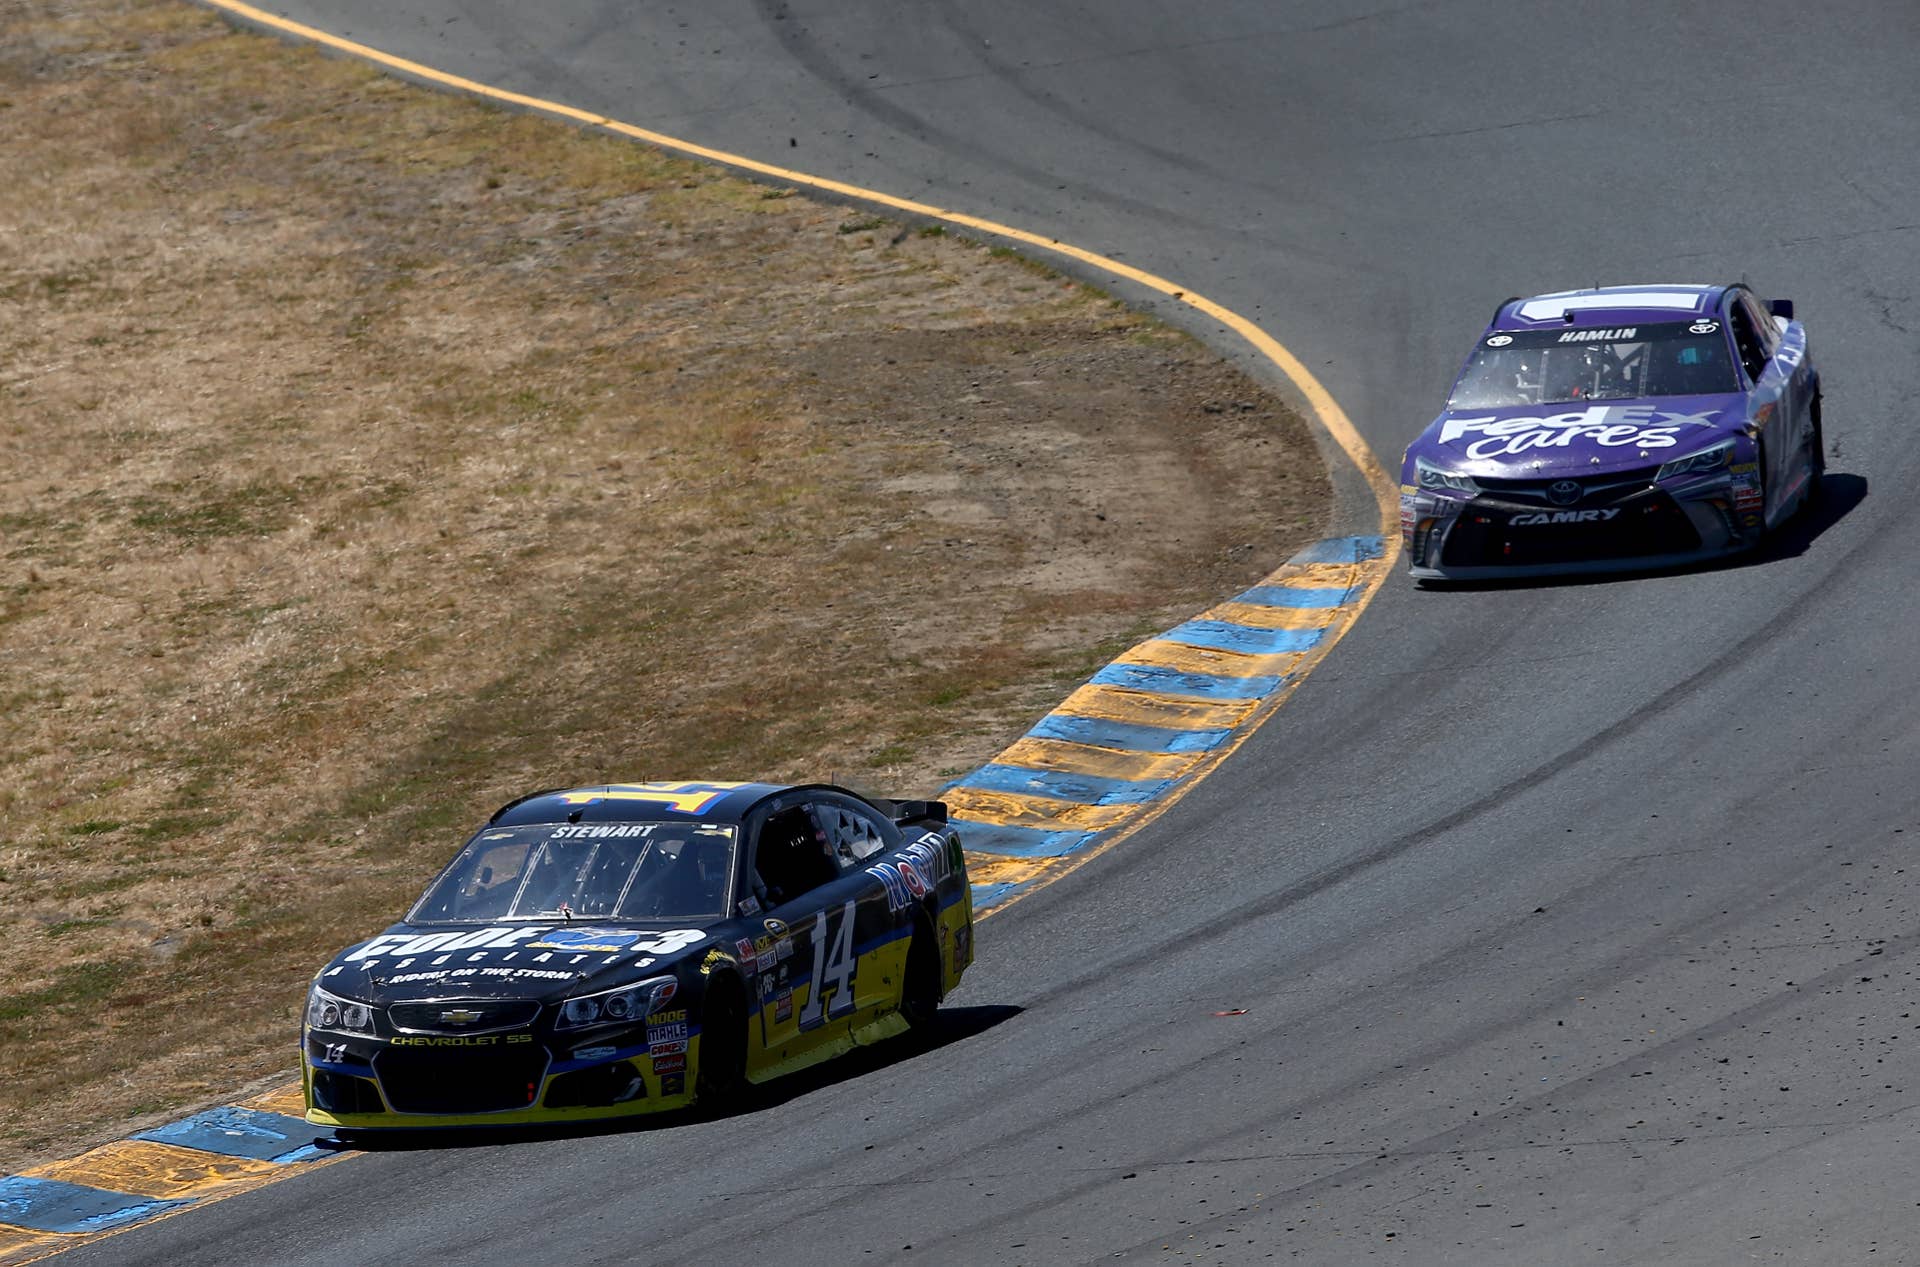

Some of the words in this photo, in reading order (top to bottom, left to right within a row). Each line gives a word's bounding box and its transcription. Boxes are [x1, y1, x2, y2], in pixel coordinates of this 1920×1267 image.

[1558, 327, 1637, 343] HAMLIN
[1438, 405, 1724, 445] FedEx
[1508, 507, 1622, 527] CAMRY
[550, 824, 658, 839] STEWART
[344, 926, 554, 962] CODE
[630, 929, 707, 955] 3
[323, 949, 657, 978] ASSOCIATES
[800, 900, 857, 1025] 14
[388, 969, 452, 985] RIDERS
[450, 967, 475, 978] ON
[479, 967, 512, 977] THE
[512, 967, 573, 981] STORM
[646, 1009, 688, 1025] MOOG
[389, 1035, 500, 1047] CHEVROLET
[506, 1034, 533, 1044] SS
[647, 1023, 688, 1043] MAHLE
[321, 1042, 348, 1064] 14
